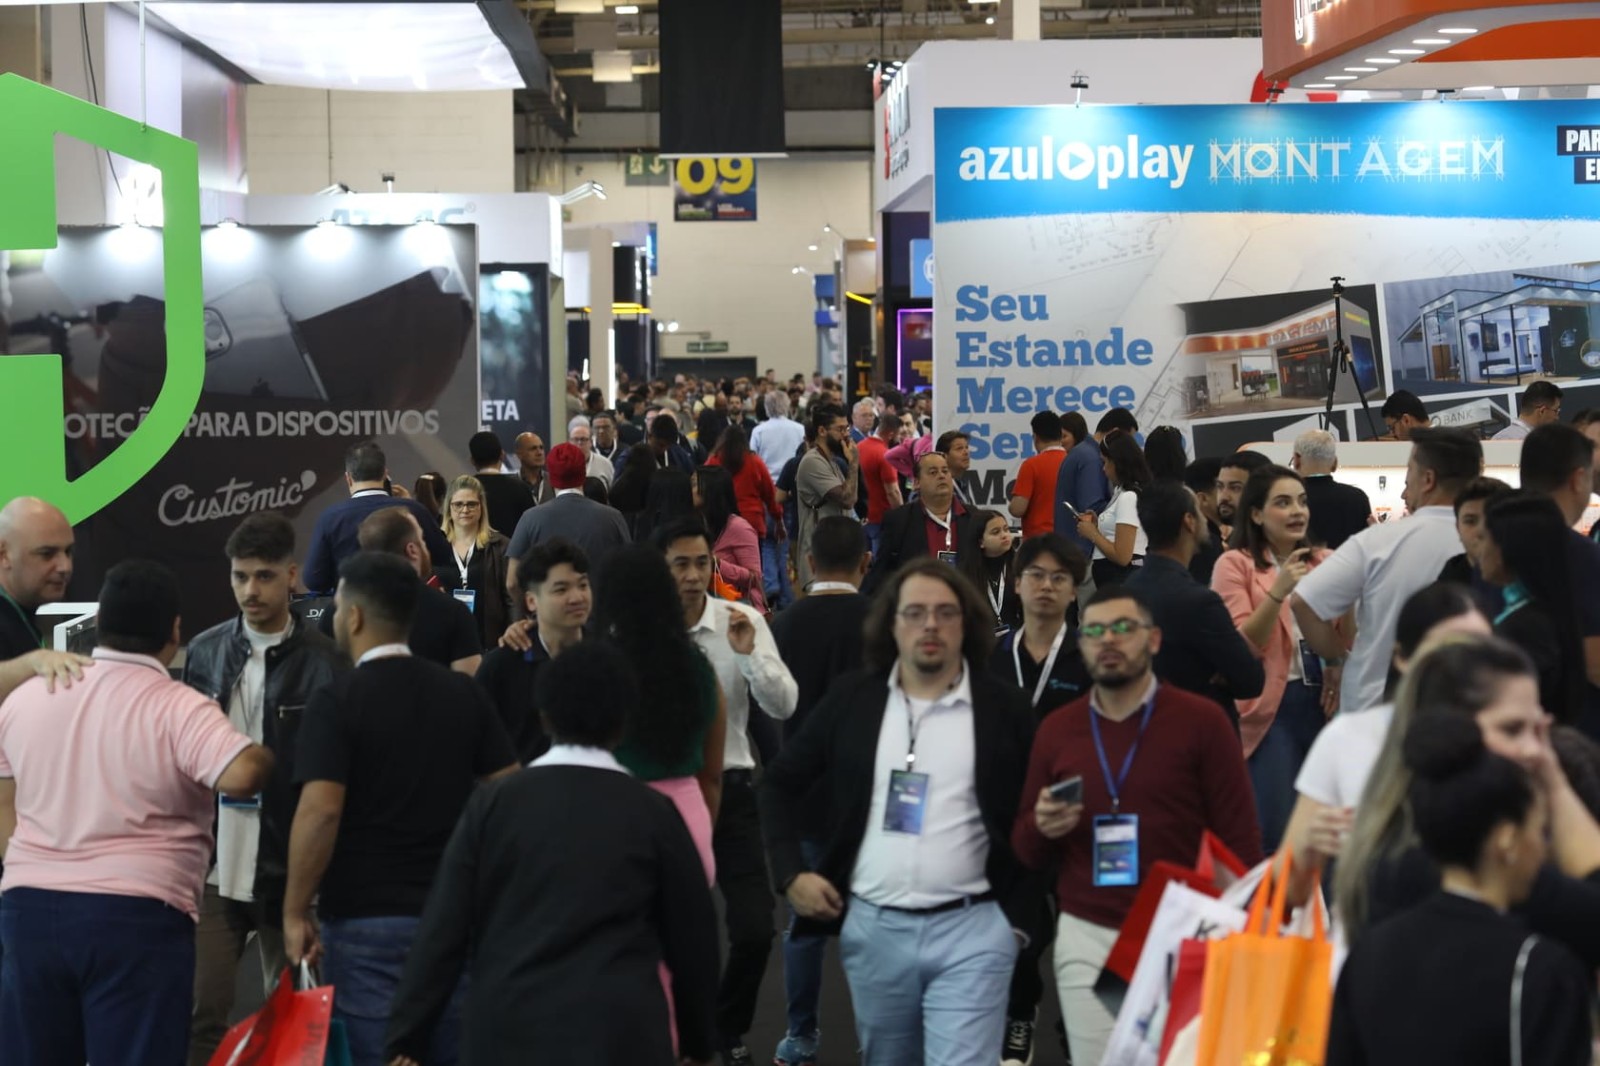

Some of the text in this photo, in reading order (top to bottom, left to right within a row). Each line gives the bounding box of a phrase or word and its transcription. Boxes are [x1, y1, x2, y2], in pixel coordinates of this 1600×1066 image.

[676, 157, 754, 194] 09
[1208, 140, 1505, 180] MONTAGEM
[955, 284, 1049, 322] Seu
[955, 327, 1154, 368] Estande
[481, 400, 520, 422] ETA
[956, 377, 1136, 414] Merece
[184, 411, 250, 438] PARA
[256, 409, 440, 437] DISPOSITIVOS
[158, 475, 304, 526] Customic
